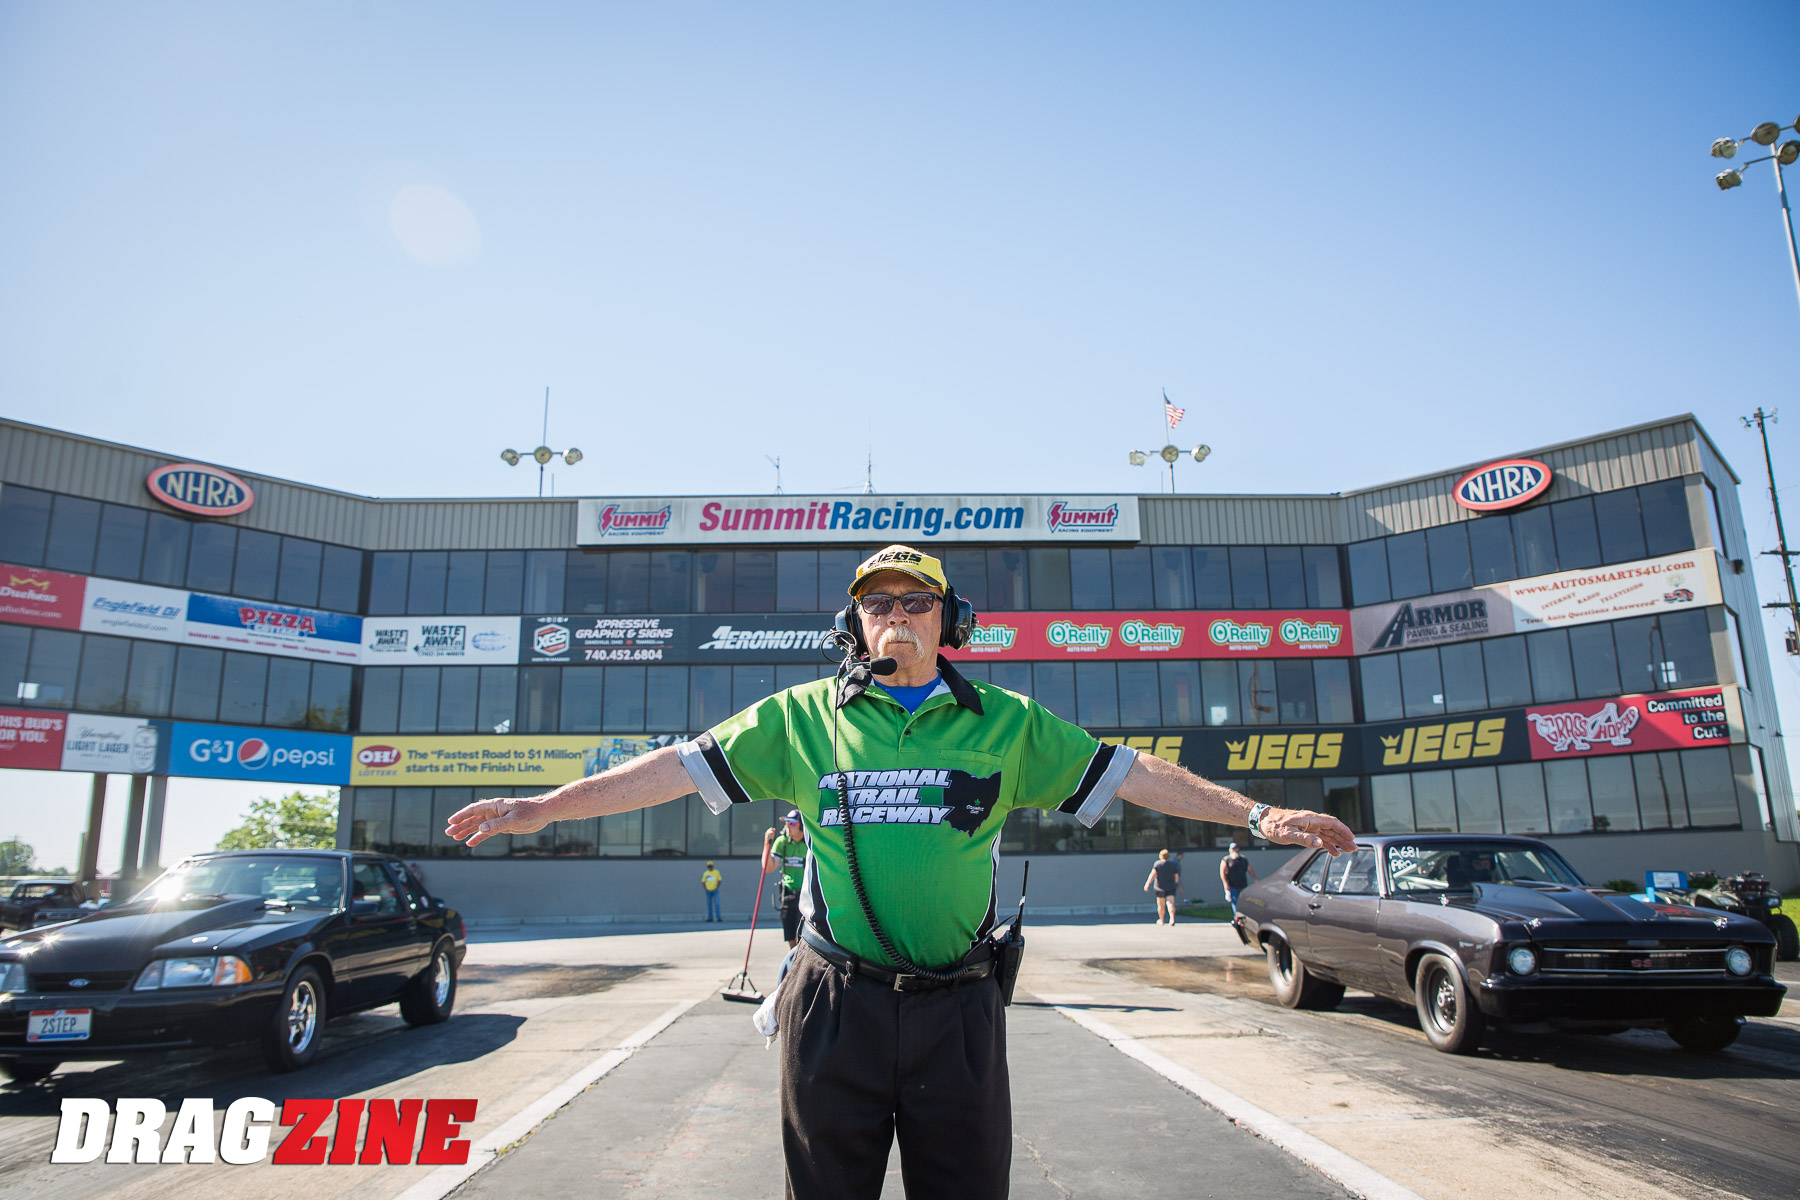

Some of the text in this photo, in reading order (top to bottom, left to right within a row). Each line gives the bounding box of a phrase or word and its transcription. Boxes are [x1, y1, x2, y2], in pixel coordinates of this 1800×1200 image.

[166, 472, 238, 506] NHRA
[1468, 467, 1536, 502] NHRA
[699, 501, 1025, 536] SummitRacing.com
[239, 606, 316, 635] PIZZA
[594, 618, 660, 630] XPRESSIVE
[1406, 619, 1488, 639] PAVING & SEALING
[422, 625, 462, 636] WASTE
[574, 628, 674, 640] GRAPHIX & SIGNS
[1051, 621, 1108, 647] O'Reilly
[1124, 620, 1182, 646] O'Reilly
[1213, 620, 1271, 645] O'Reilly
[1283, 619, 1340, 644] O'Reilly
[423, 636, 457, 648] AWAY
[537, 630, 568, 650] XGS
[585, 649, 663, 661] 740.452.6804
[1647, 694, 1722, 713] Committed
[0, 715, 63, 731] HIS BUD'S
[1684, 709, 1725, 724] to the
[66, 741, 97, 750] LIGHT
[99, 743, 129, 753] LAGER
[1383, 717, 1506, 767] JEGS
[189, 739, 335, 768] G&J pepsi
[358, 749, 398, 763] OH!
[407, 750, 428, 759] The
[482, 750, 510, 759] Road
[513, 750, 525, 759] to
[528, 750, 542, 760] $1
[1229, 733, 1344, 771] JEGS
[406, 763, 545, 772] starts at The Finish Line.
[848, 787, 920, 805] TRAIL
[1389, 846, 1420, 860] A681
[1391, 859, 1412, 872] PRO
[1631, 958, 1652, 968] SS
[41, 1017, 77, 1034] 2STEP
